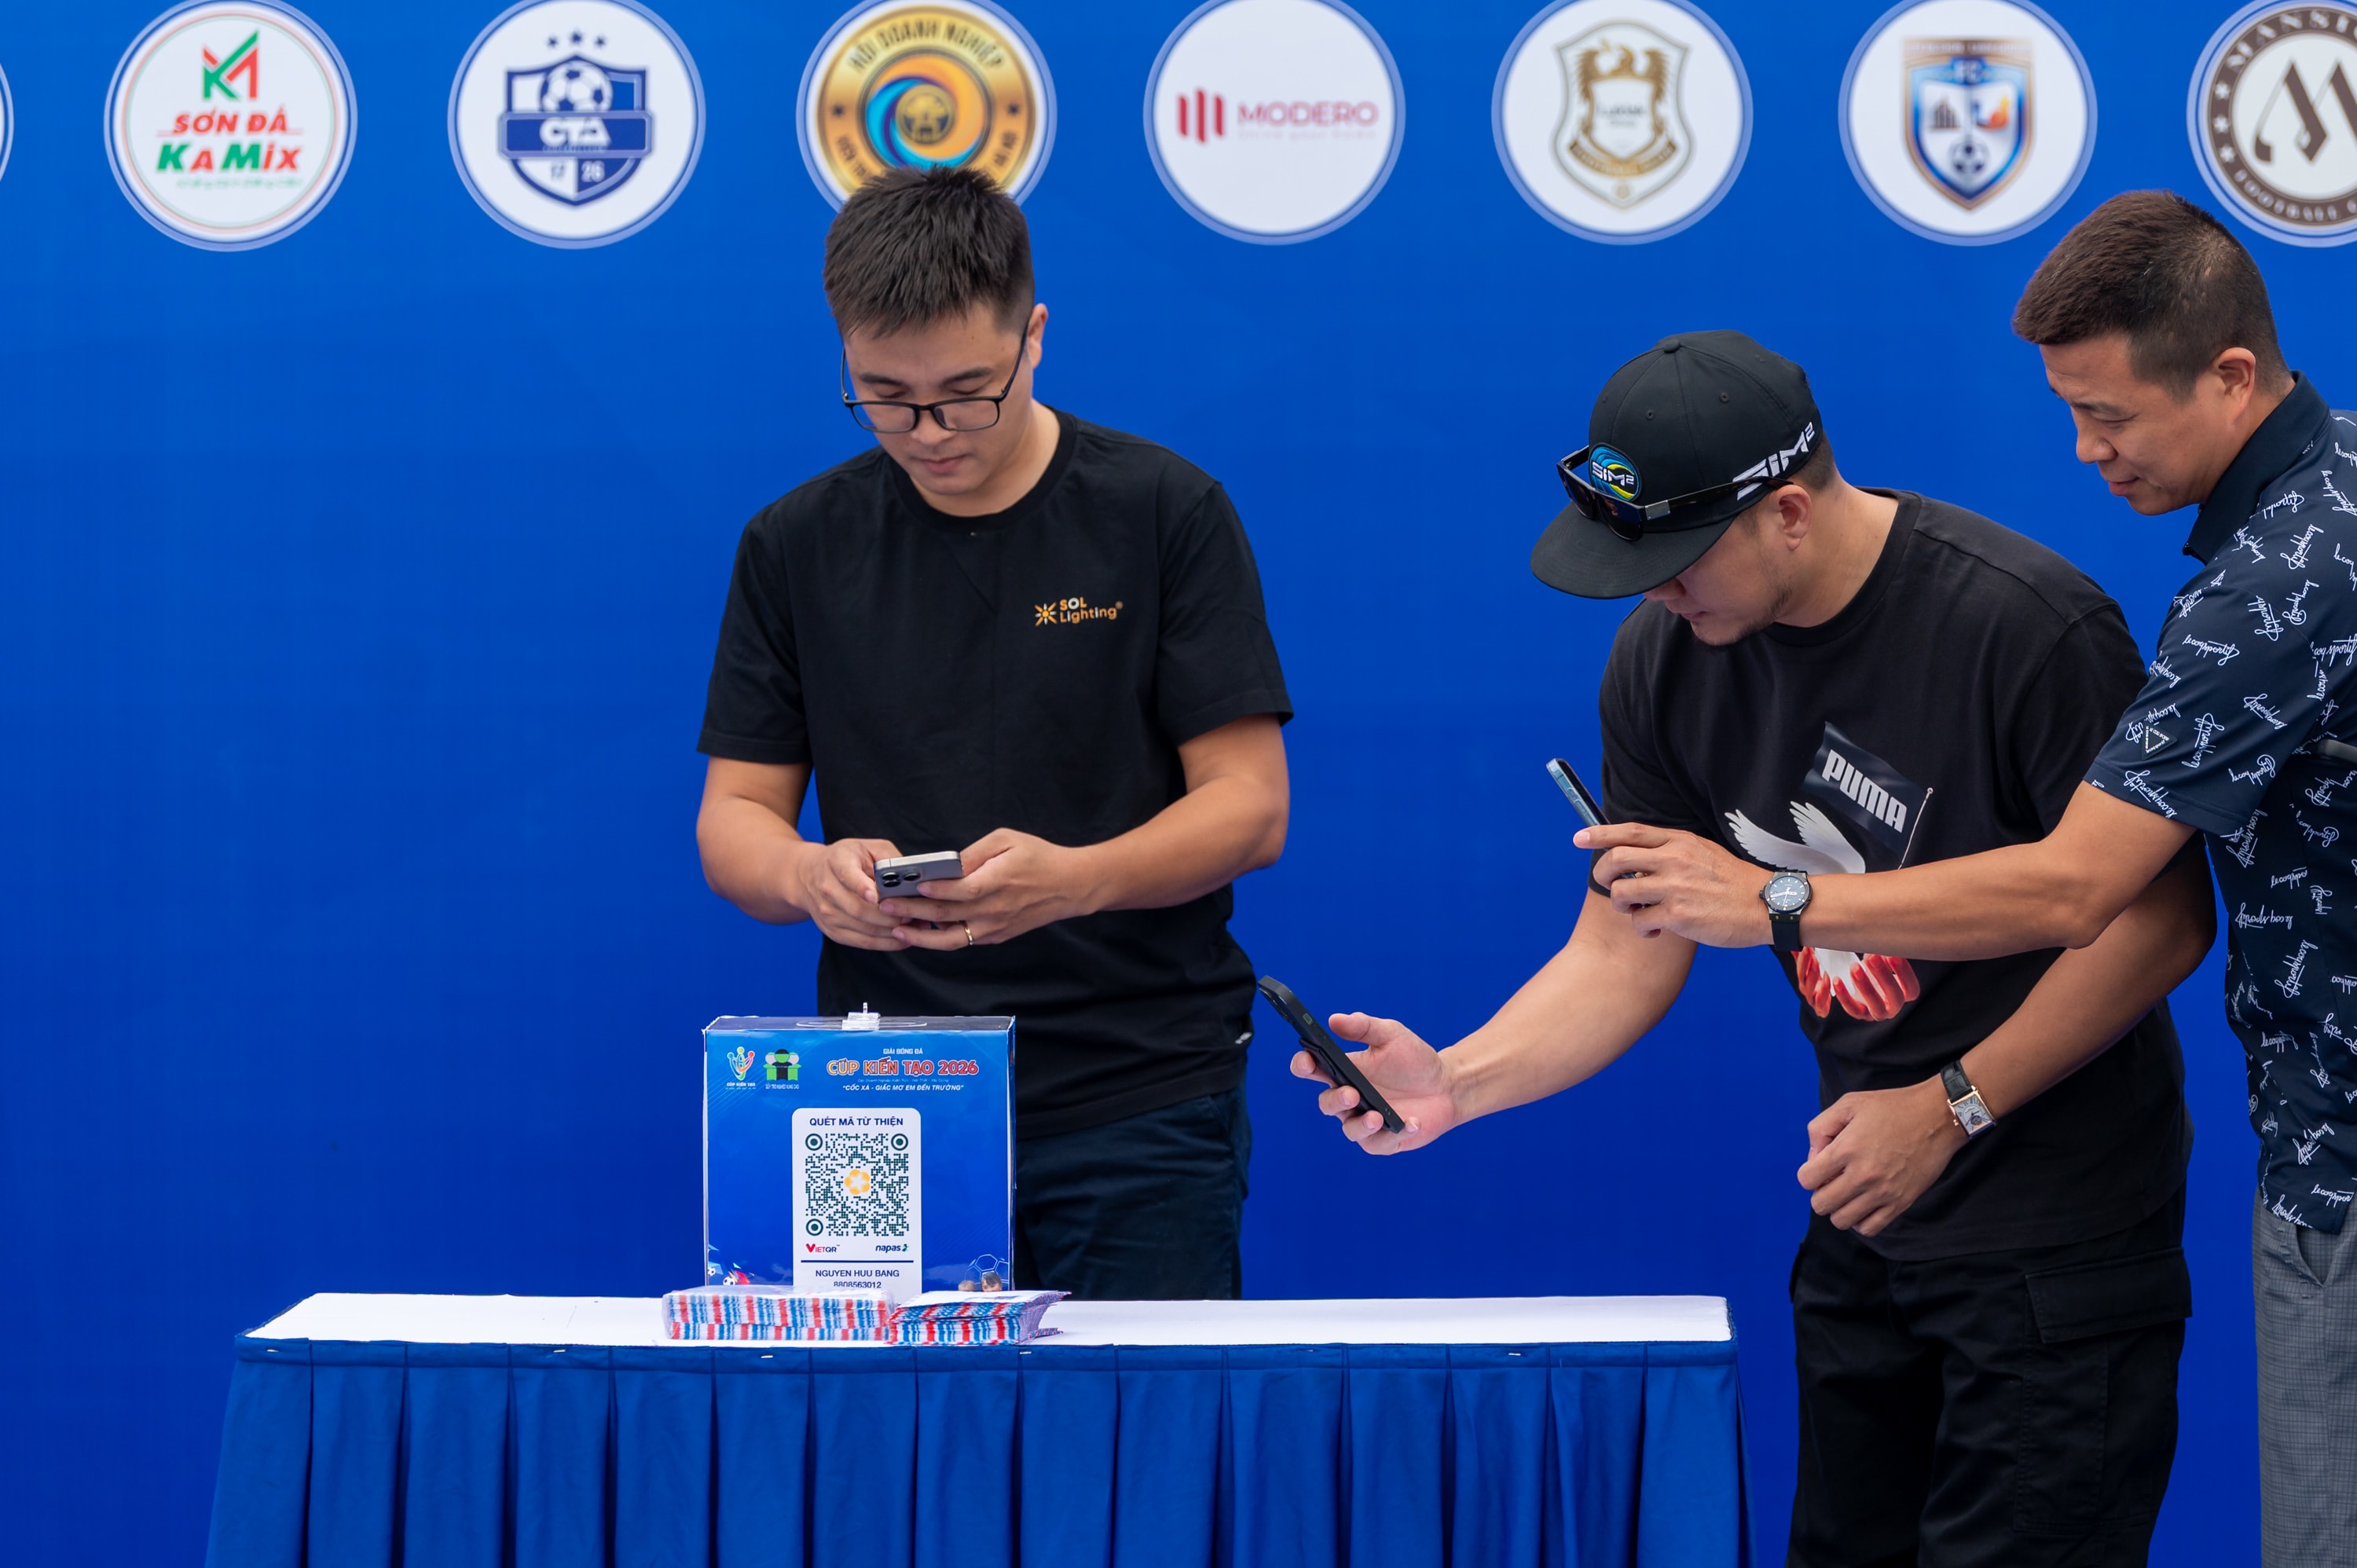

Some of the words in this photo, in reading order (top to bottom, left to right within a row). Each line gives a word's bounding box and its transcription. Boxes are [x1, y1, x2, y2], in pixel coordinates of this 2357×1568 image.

[2226, 10, 2357, 72] MANSI
[174, 108, 238, 134] SƠN
[247, 104, 288, 134] ĐÁ
[1237, 101, 1379, 127] MODERO
[1060, 597, 1087, 611] SOL
[1822, 749, 1907, 833] PUMA
[827, 1058, 859, 1075] CÚP
[863, 1057, 899, 1075] KIẾN
[903, 1060, 933, 1077] TẠO
[938, 1060, 979, 1075] 2026
[809, 1116, 836, 1126] QUÉT
[839, 1116, 854, 1126] MÃ
[857, 1116, 871, 1126] TỪ
[874, 1116, 903, 1127] THIỆN
[875, 1244, 901, 1253] napas
